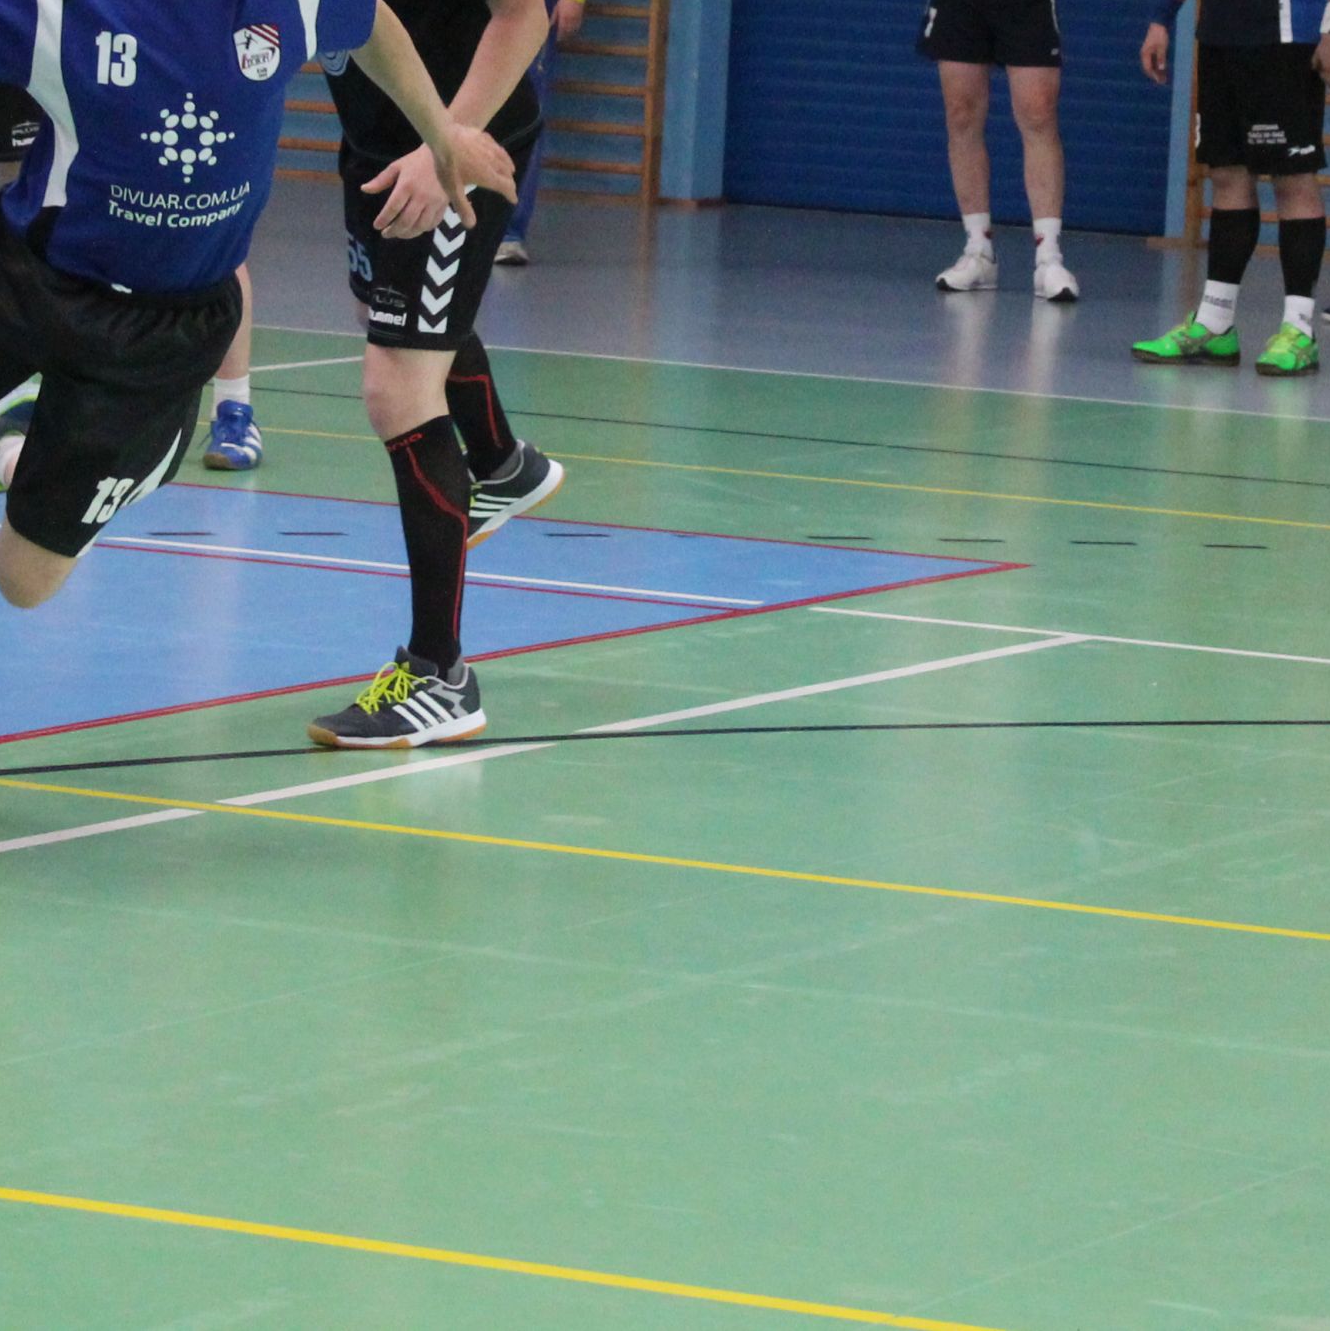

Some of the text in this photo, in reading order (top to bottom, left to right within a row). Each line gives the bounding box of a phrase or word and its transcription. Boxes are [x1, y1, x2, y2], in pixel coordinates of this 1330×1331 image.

[95, 30, 137, 87] 13
[109, 199, 244, 228] Travel Company
[110, 181, 251, 211] DIVUAR.COM.UA
[80, 475, 135, 525] 13
